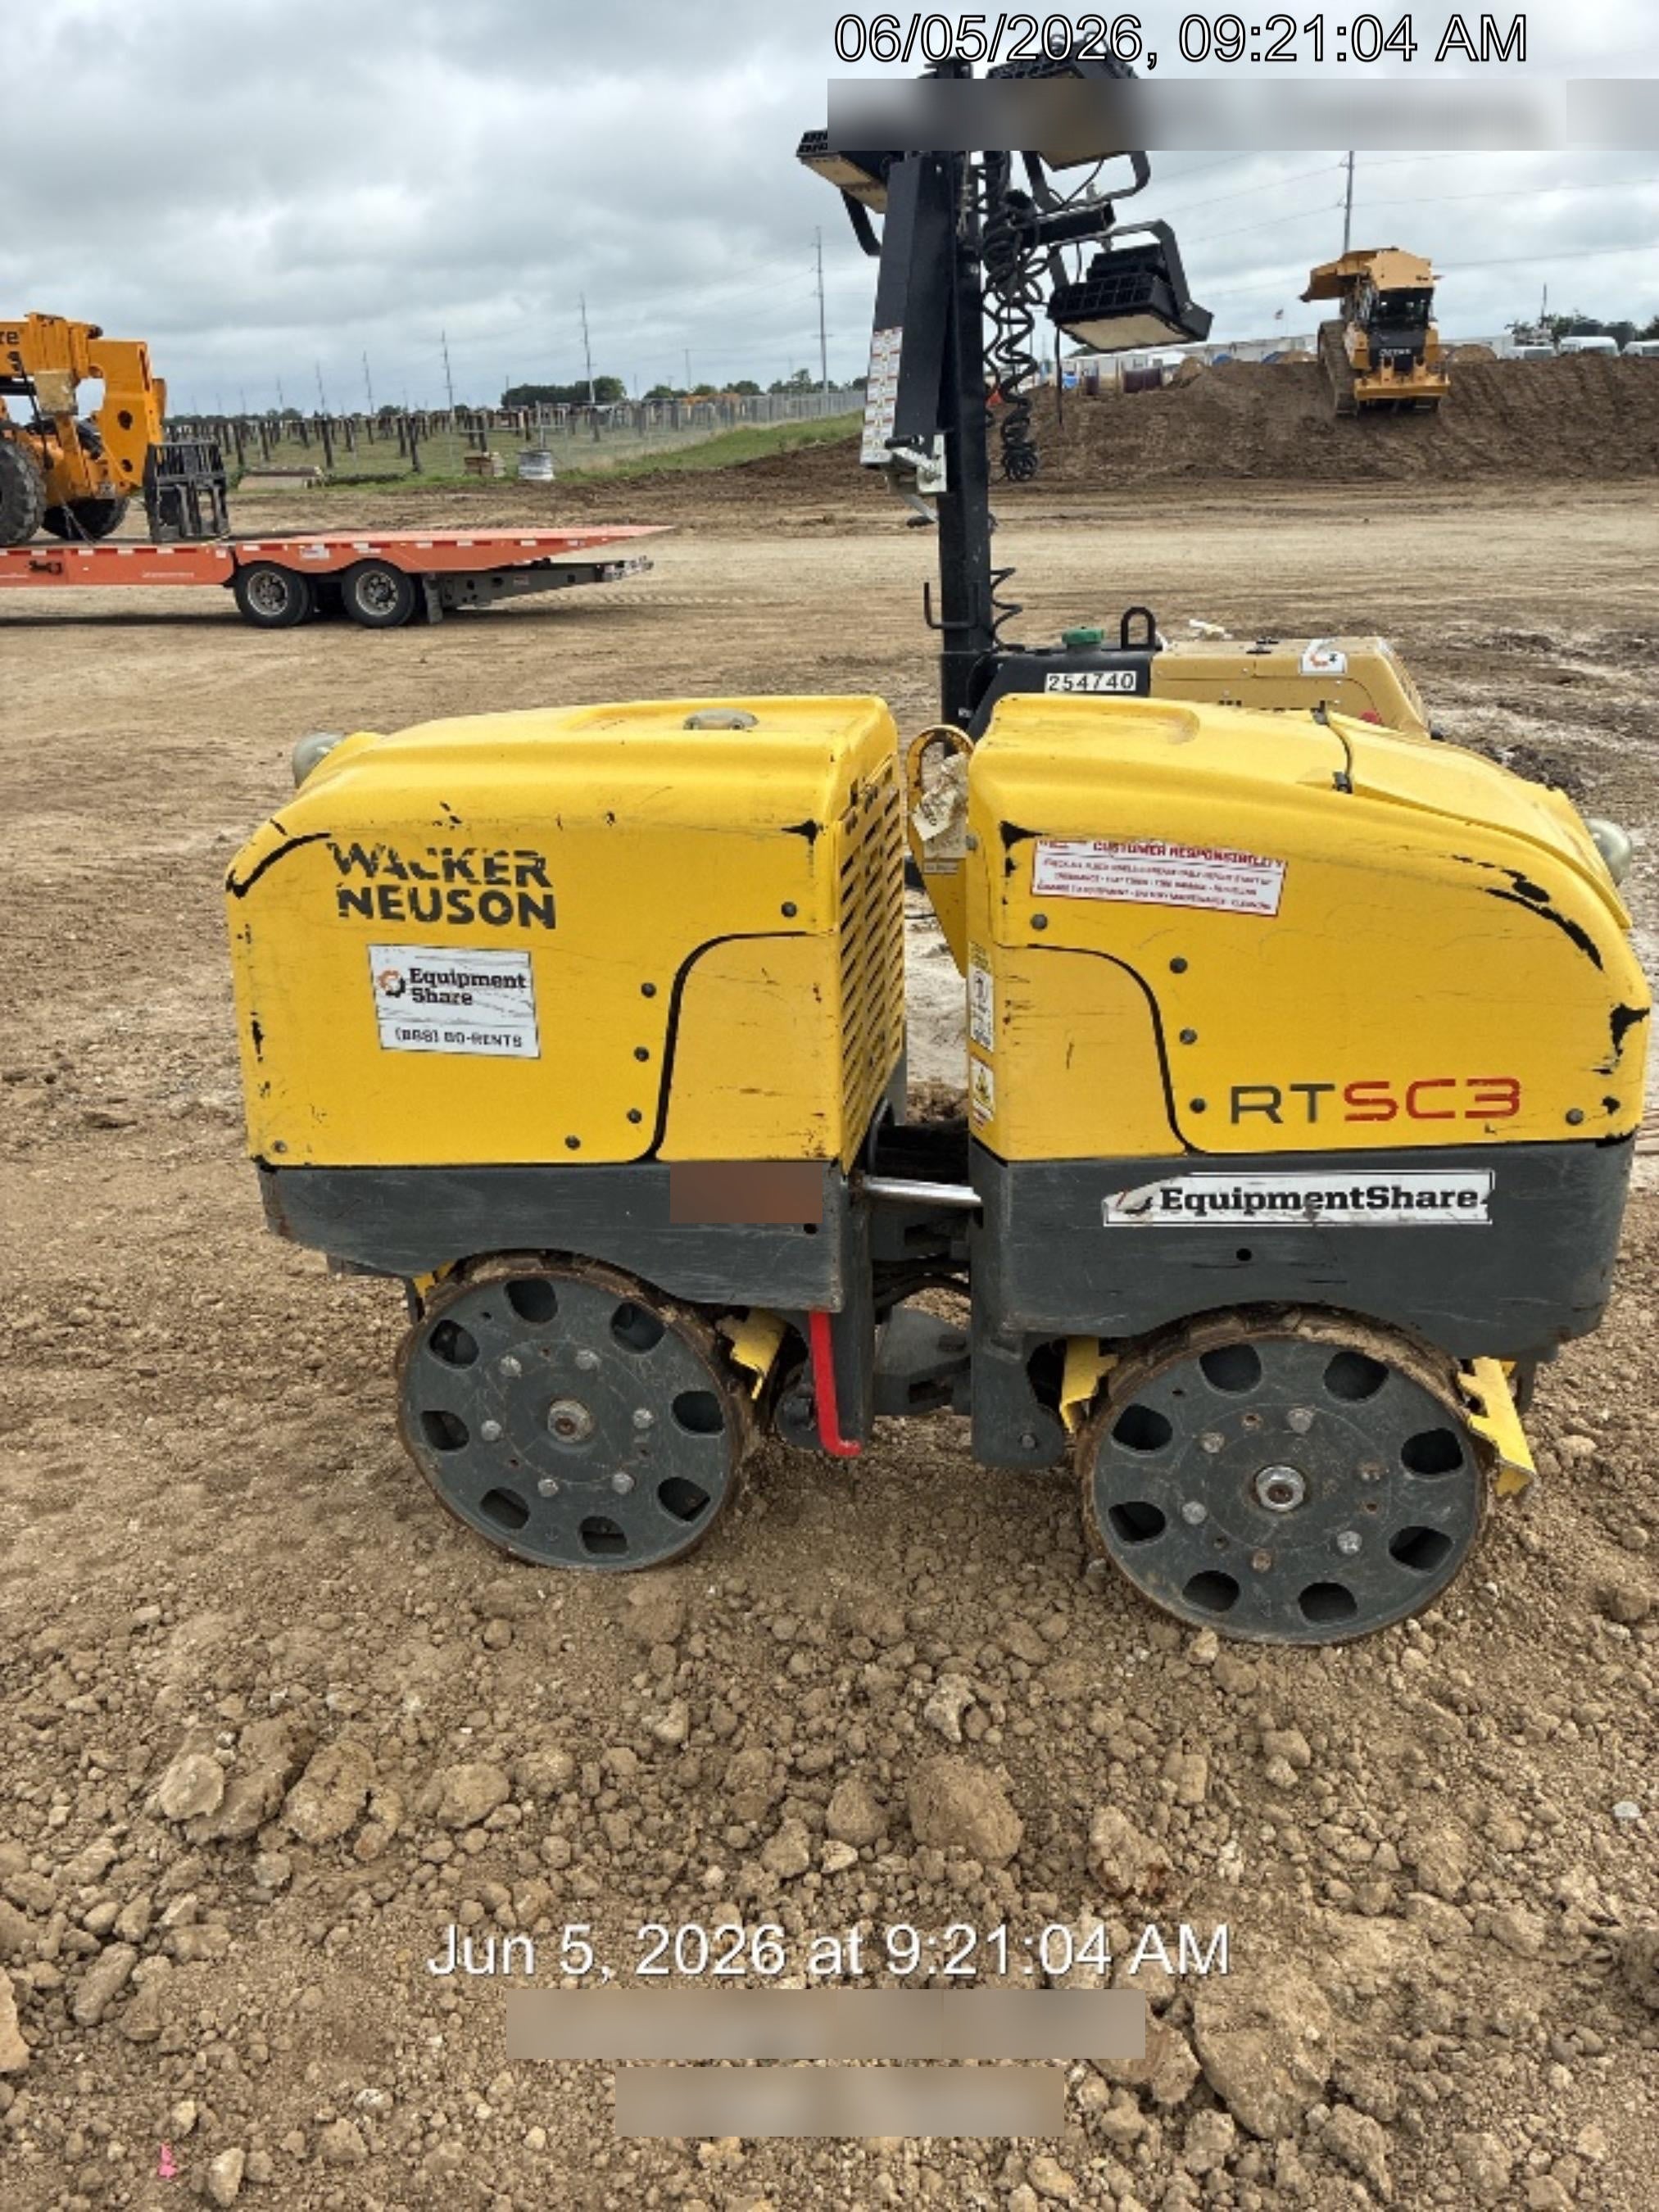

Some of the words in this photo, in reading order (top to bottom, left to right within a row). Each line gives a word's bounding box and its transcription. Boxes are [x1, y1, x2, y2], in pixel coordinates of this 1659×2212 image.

[1048, 673, 1135, 692] 254740
[326, 842, 554, 888] WACKER
[336, 883, 557, 930] NEUSON
[409, 968, 527, 990] Equipment
[411, 987, 474, 1006] Share
[1231, 1077, 1521, 1125] RTSC3
[1160, 1185, 1480, 1217] EquipmentShare
